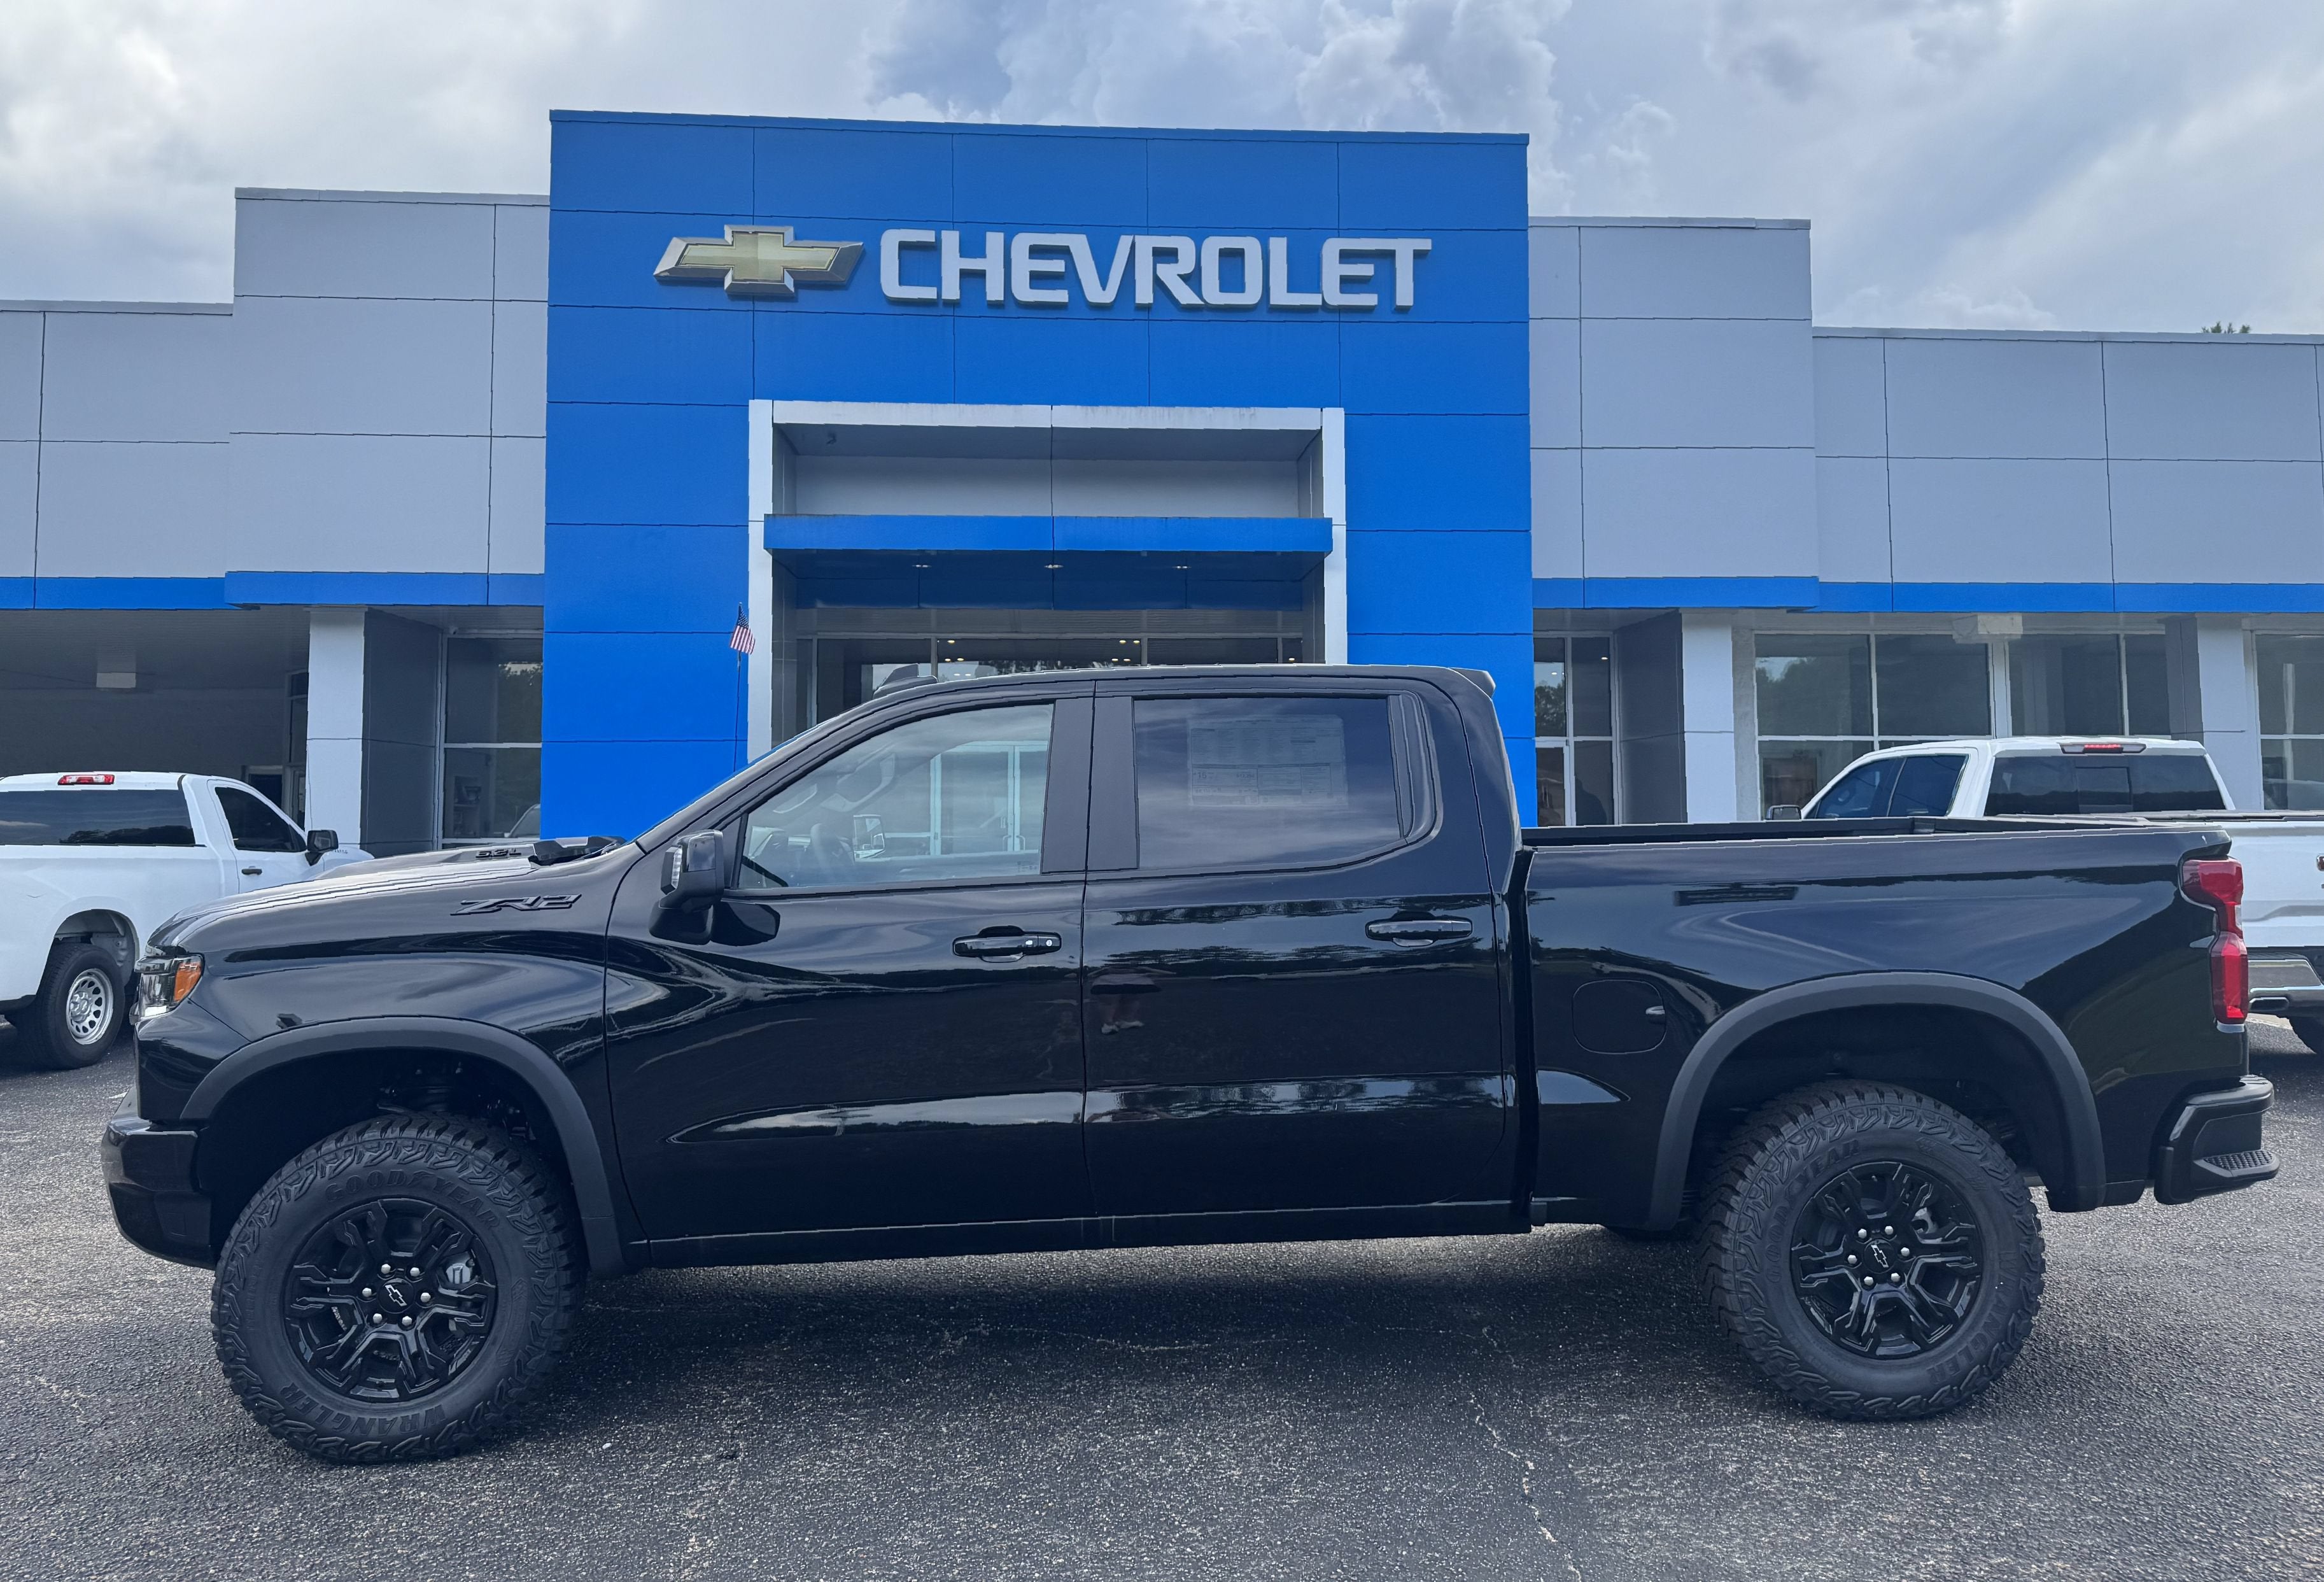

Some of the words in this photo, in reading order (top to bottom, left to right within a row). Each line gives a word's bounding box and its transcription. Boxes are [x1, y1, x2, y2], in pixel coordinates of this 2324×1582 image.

[881, 229, 1432, 309] CHEVROLET
[450, 893, 582, 916] ZR2
[325, 1169, 500, 1229] GOODYEAR
[279, 1382, 447, 1436] WRANGLER
